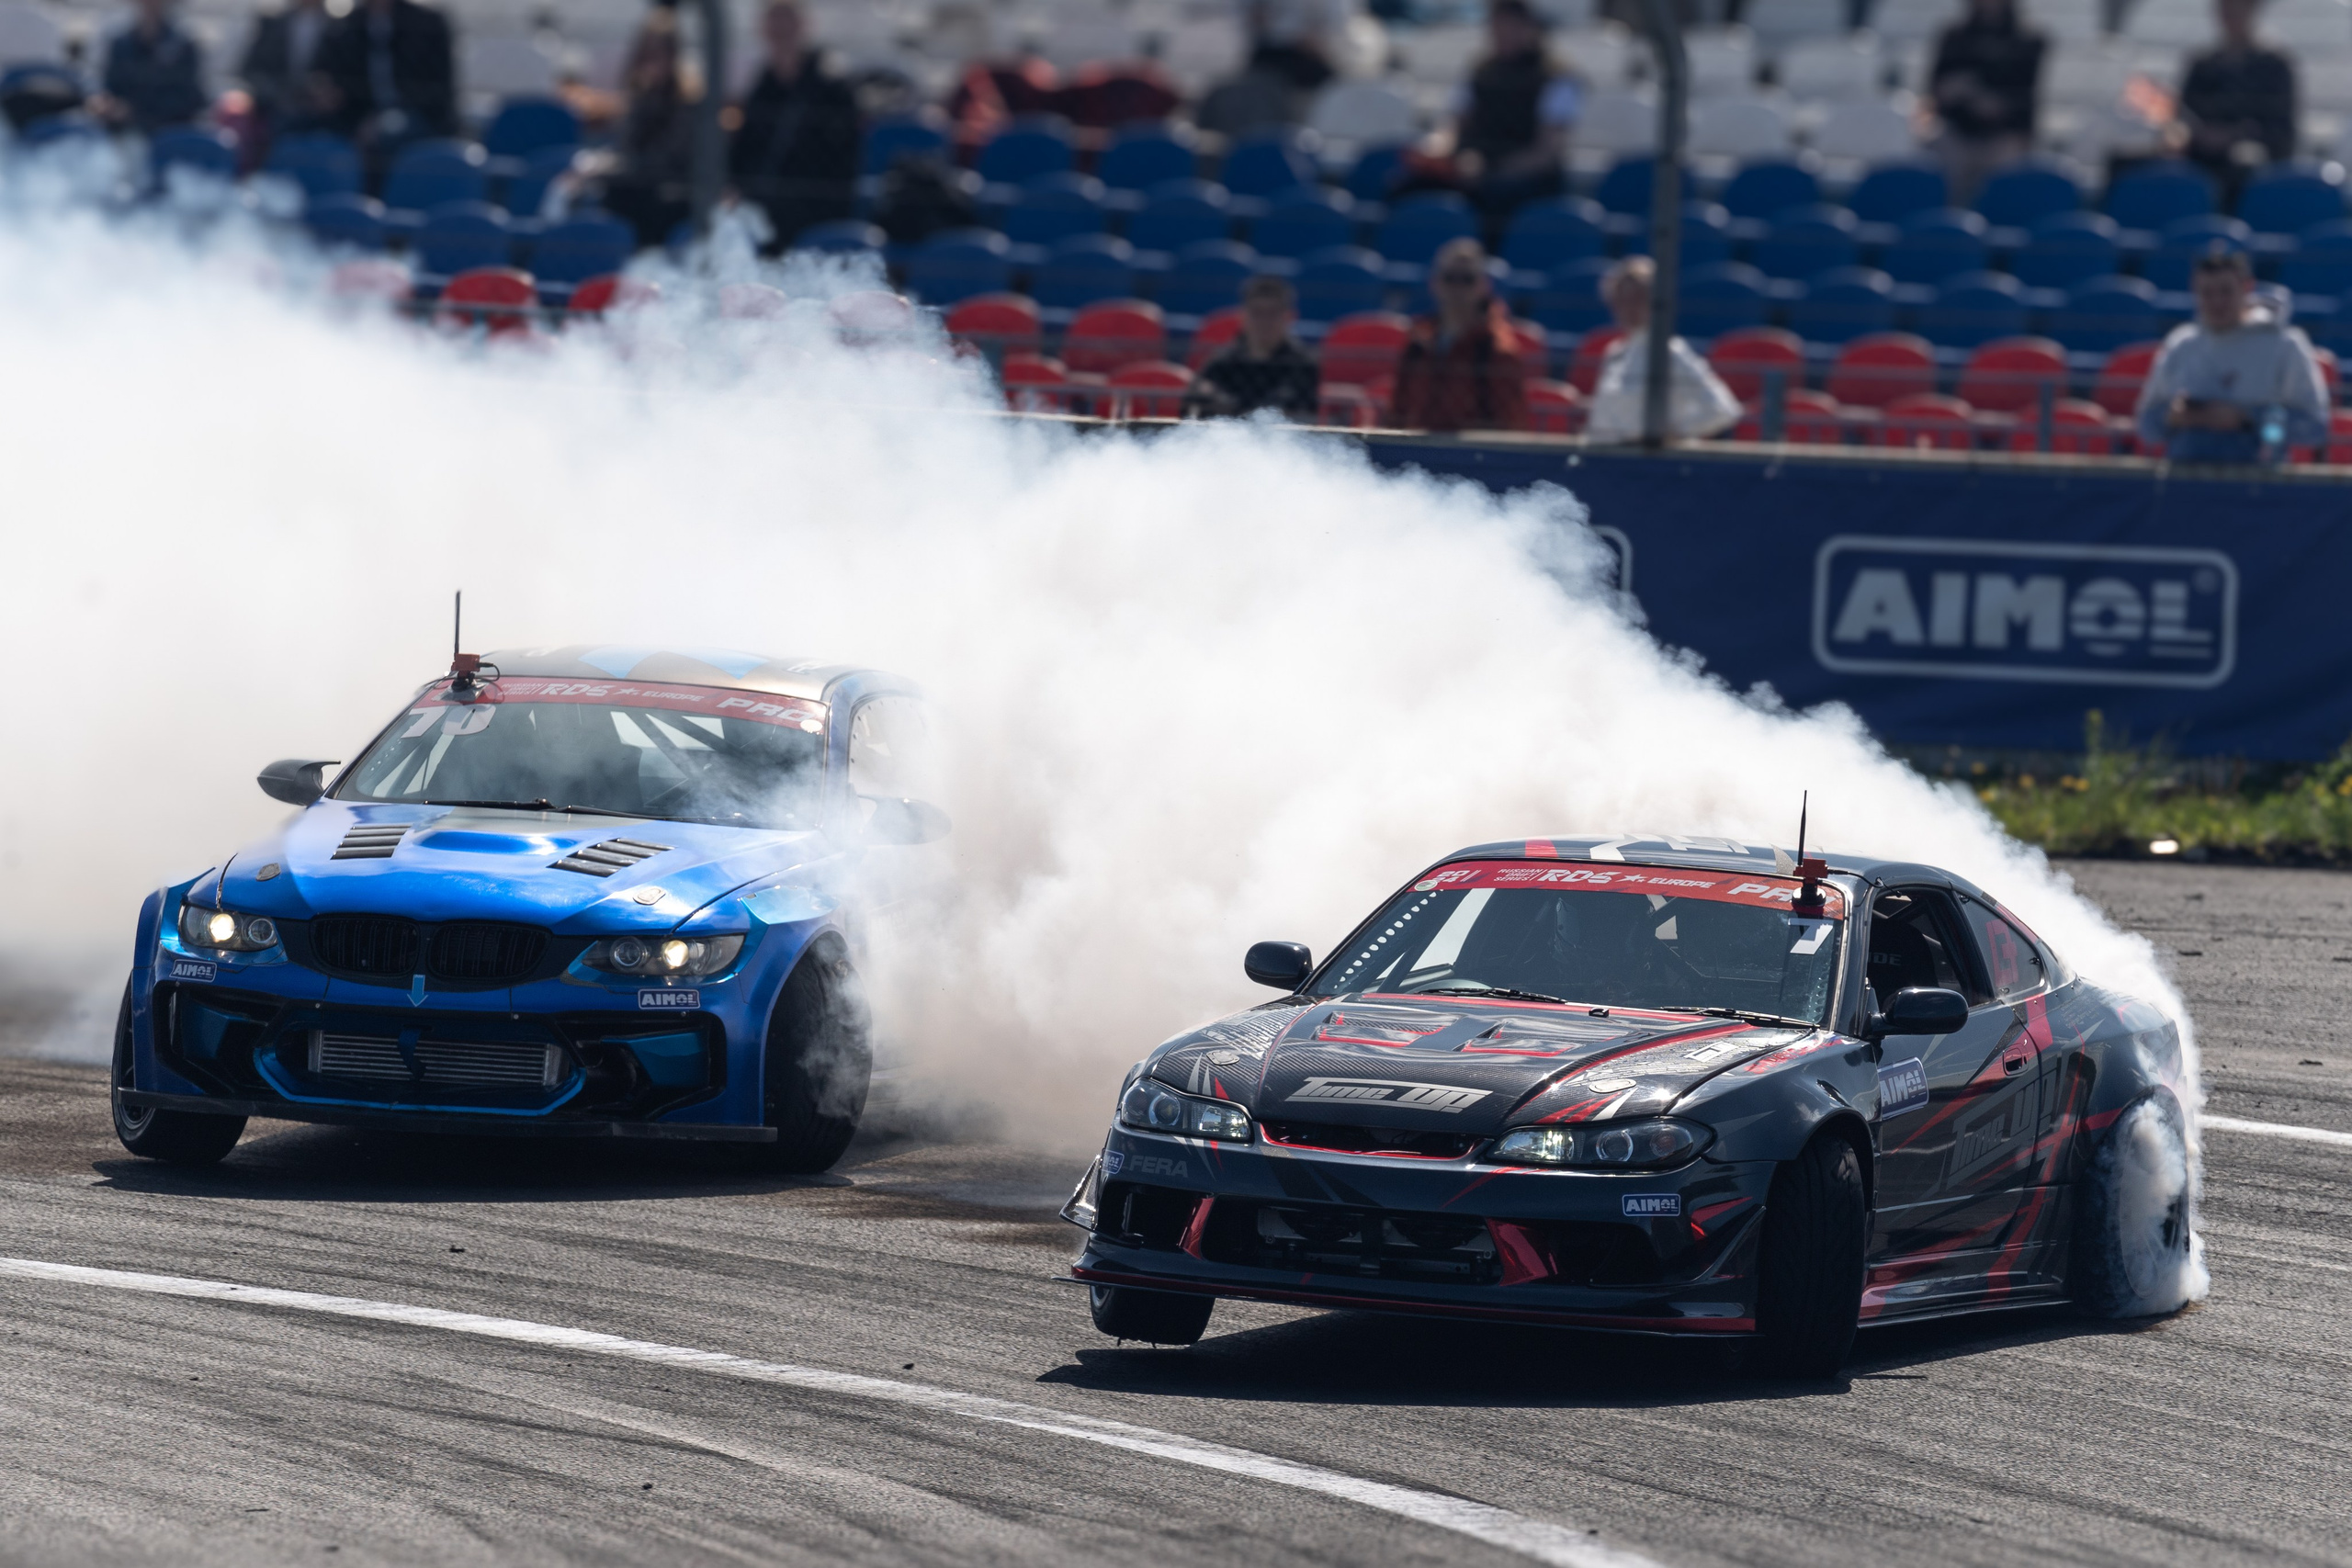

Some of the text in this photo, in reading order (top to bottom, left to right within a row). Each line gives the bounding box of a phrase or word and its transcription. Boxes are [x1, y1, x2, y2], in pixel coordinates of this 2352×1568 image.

[1835, 569, 2213, 657] AIMOL
[538, 682, 817, 722] RDS EUROPE PRO
[1536, 869, 1623, 884] RDS
[1646, 877, 1716, 889] EUROPE
[1788, 918, 1835, 955] 7
[172, 963, 215, 979] AIMOL
[641, 993, 697, 1006] AIMOL
[1881, 1069, 1926, 1107] AIMOL
[1129, 1155, 1189, 1178] FERA
[1625, 1198, 1679, 1212] AIMOL
